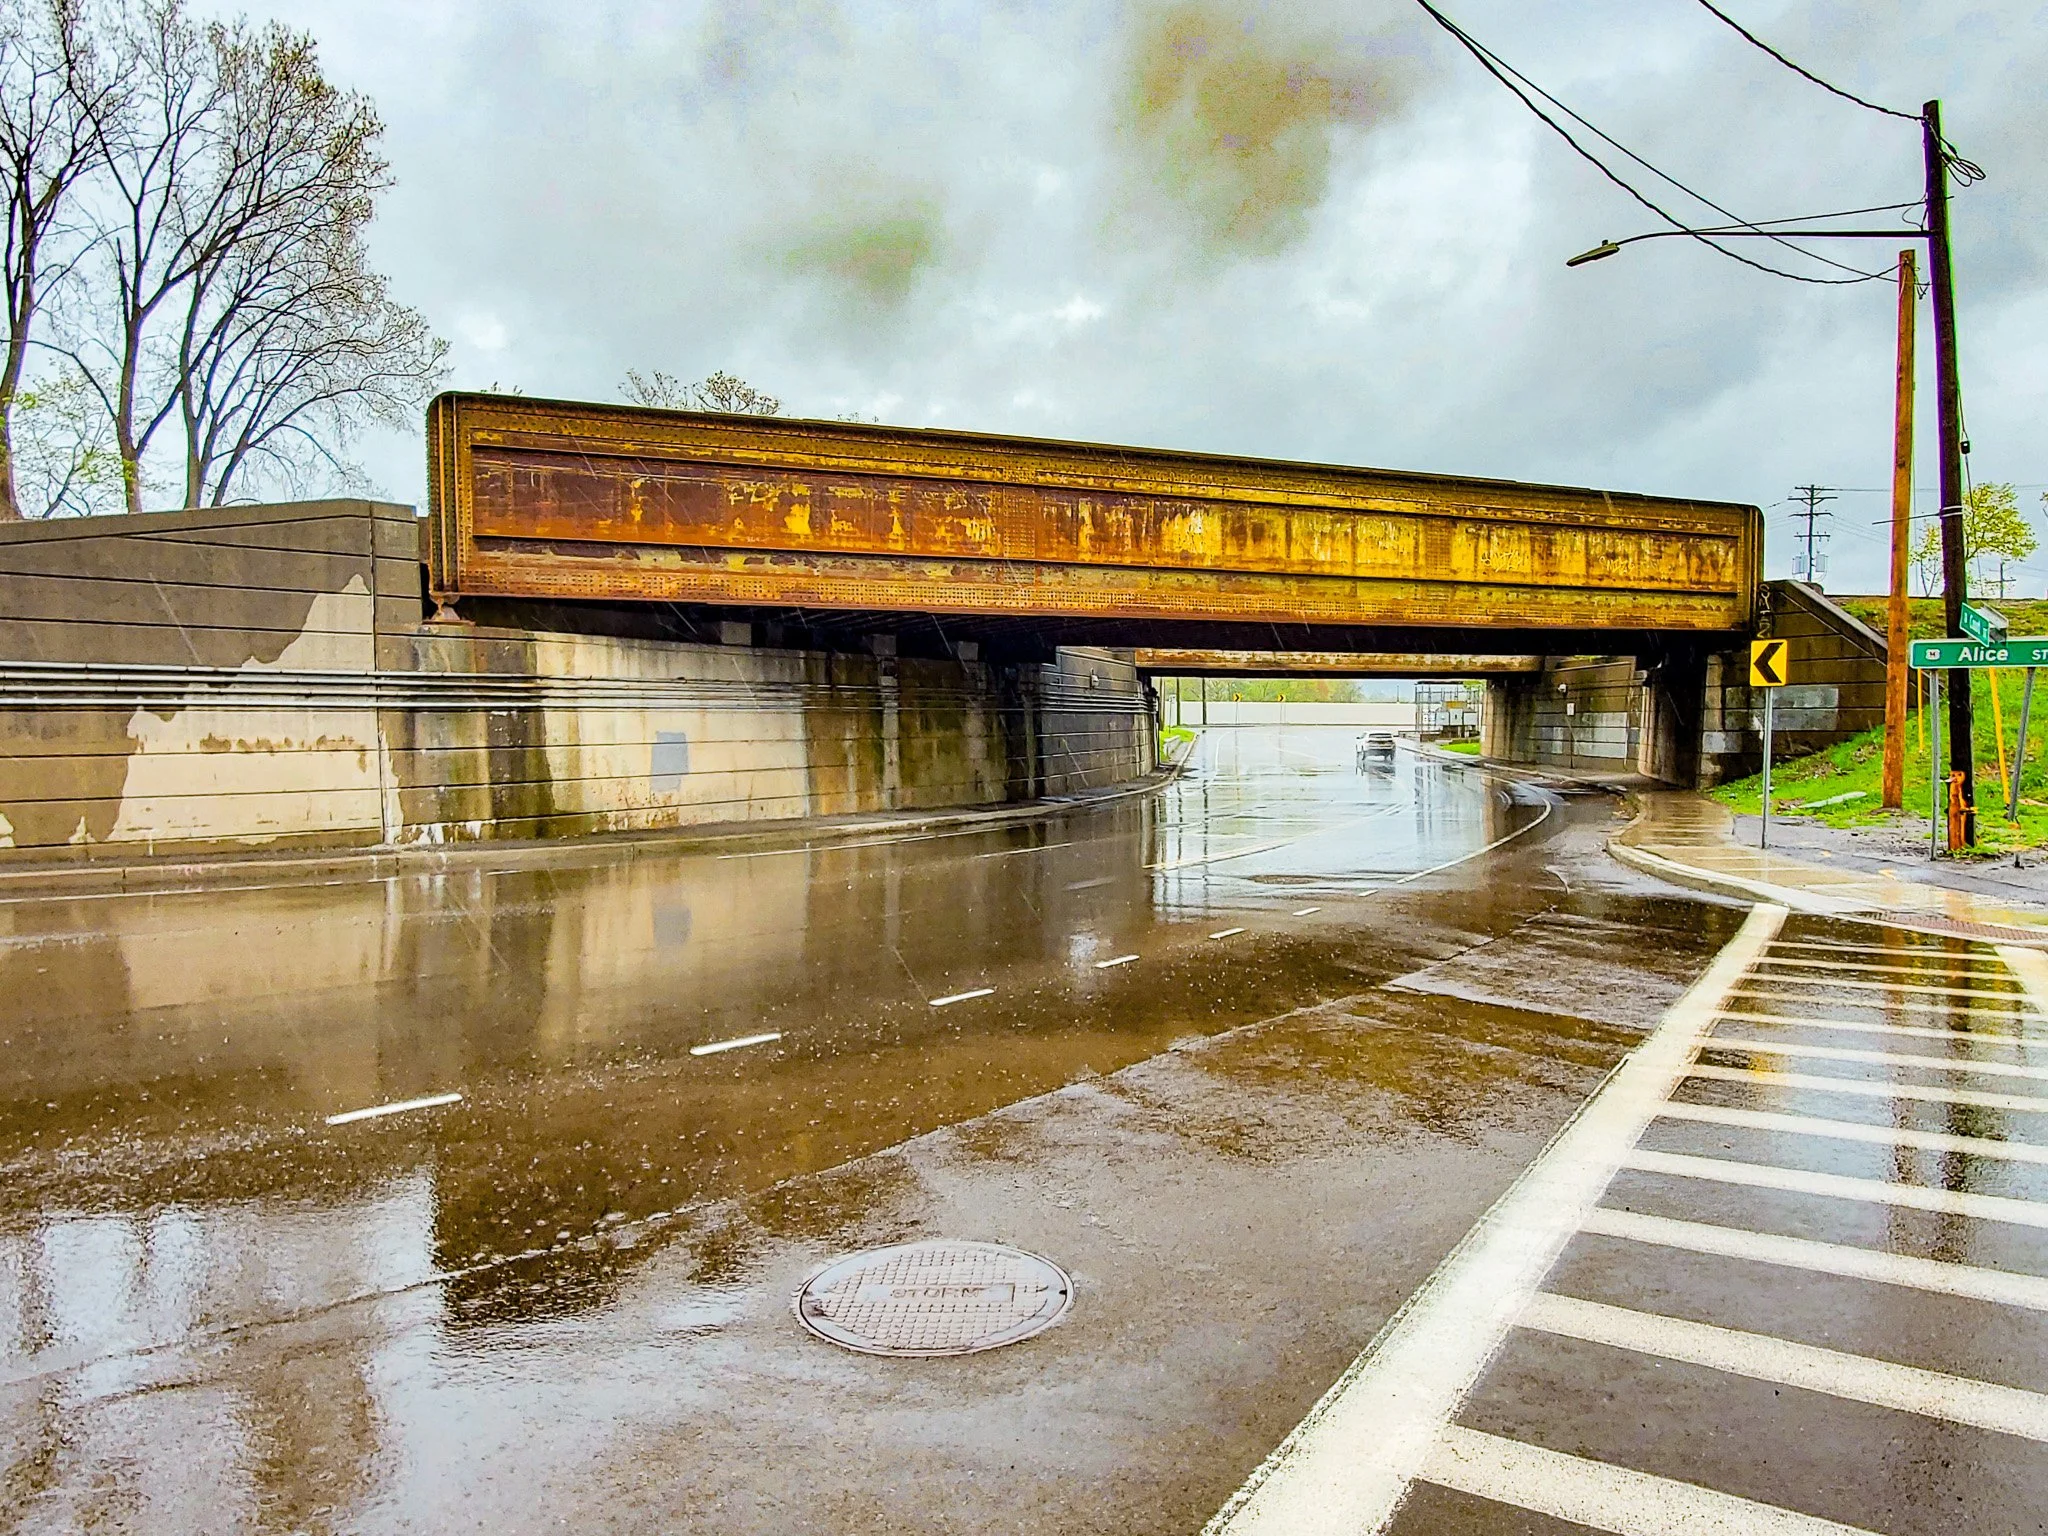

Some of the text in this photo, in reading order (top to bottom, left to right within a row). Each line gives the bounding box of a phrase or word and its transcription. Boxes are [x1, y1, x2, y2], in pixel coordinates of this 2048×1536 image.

[1958, 647, 2048, 662] Alice ST
[889, 1287, 980, 1299] STORM
